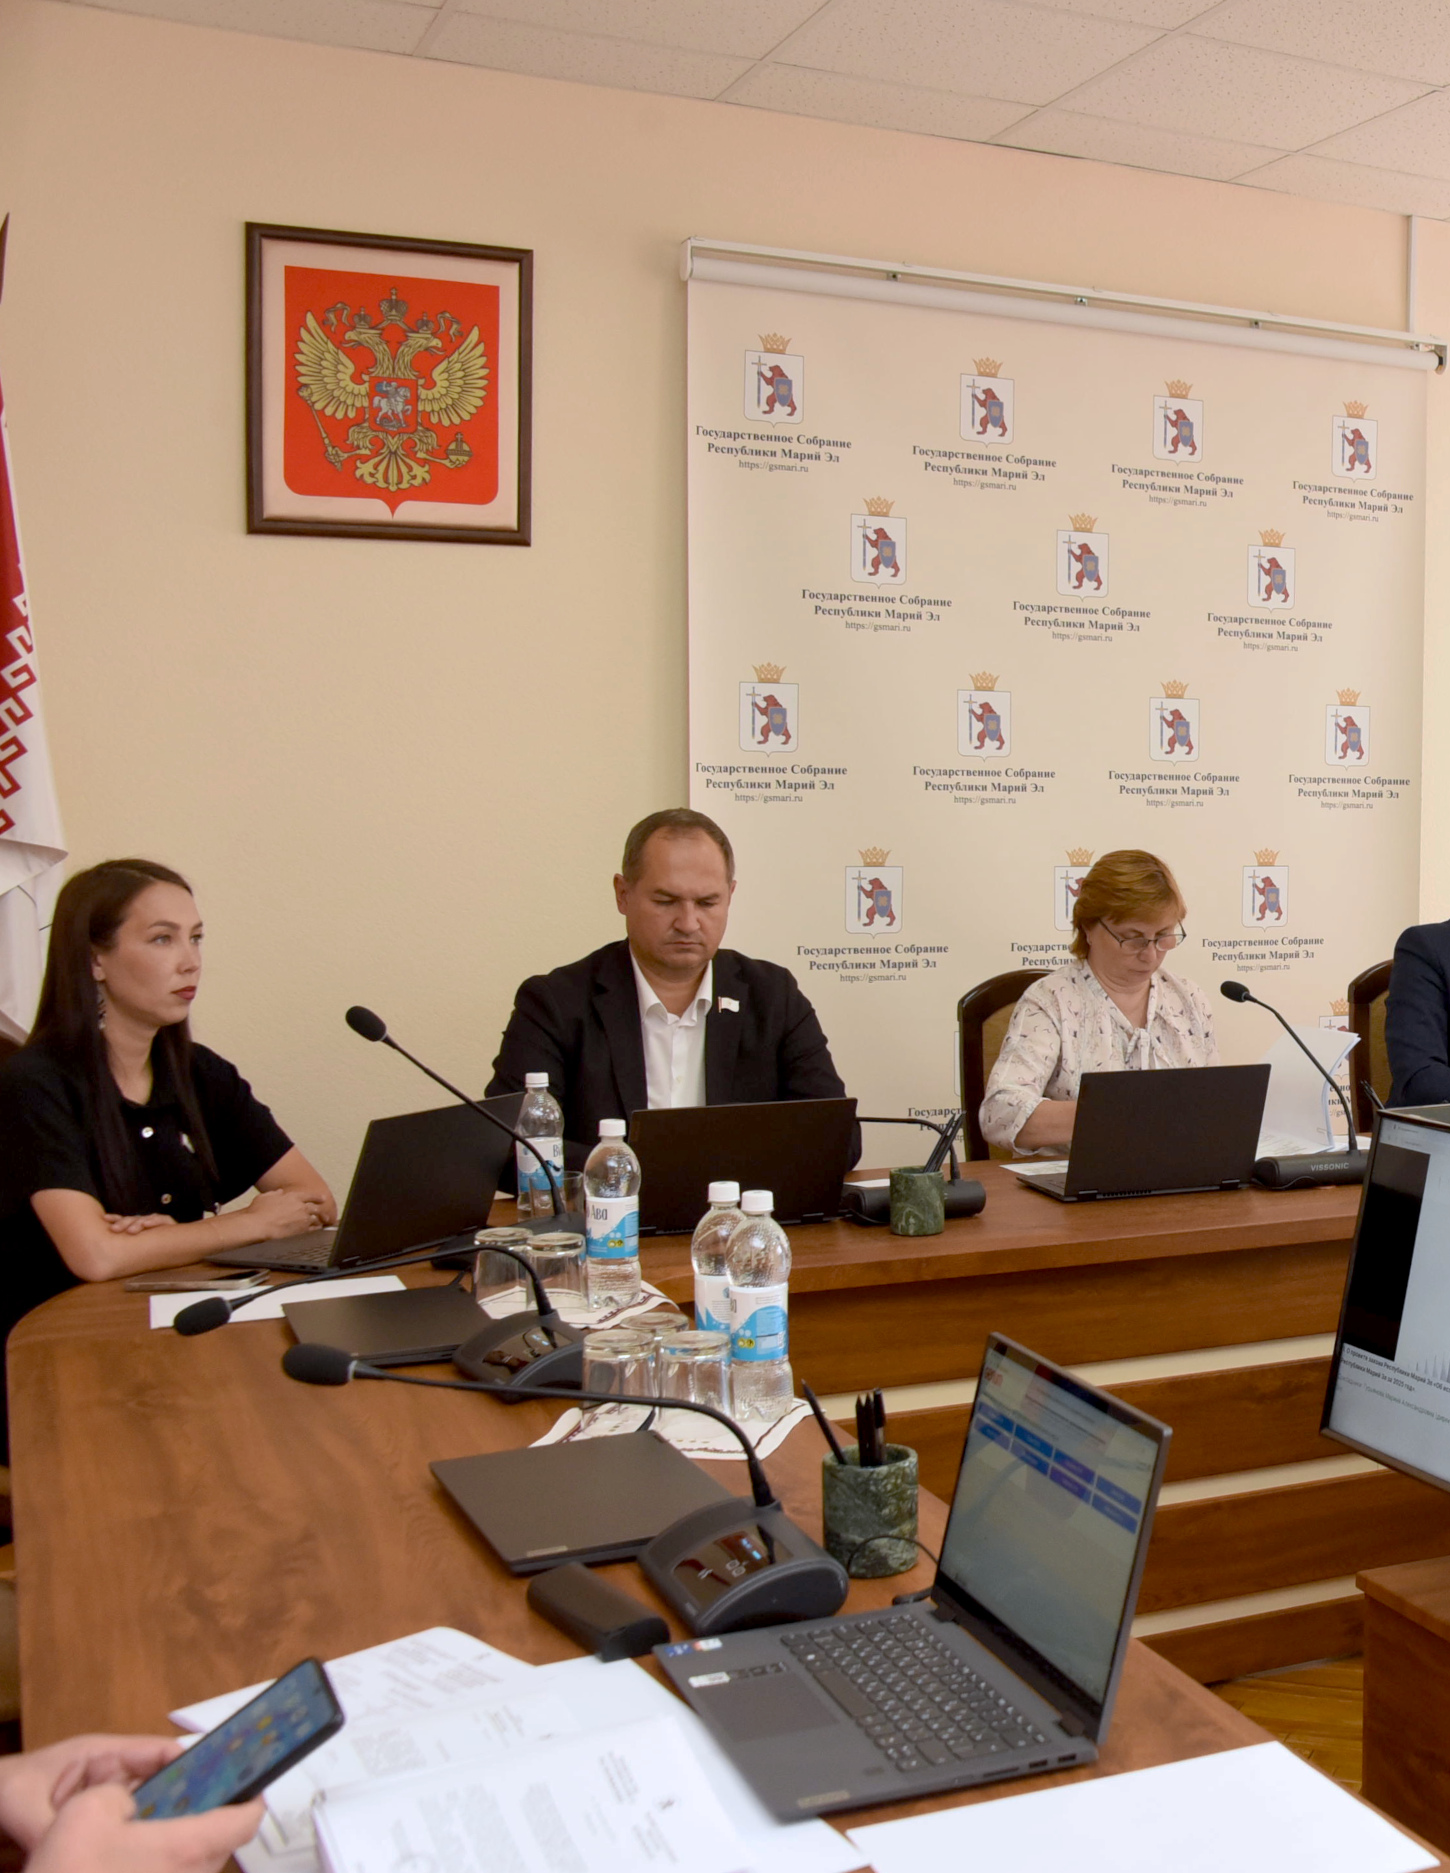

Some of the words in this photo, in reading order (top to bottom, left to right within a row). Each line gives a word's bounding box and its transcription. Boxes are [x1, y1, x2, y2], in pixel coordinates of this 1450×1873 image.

[696, 425, 794, 444] Государственное
[796, 434, 852, 449] Собрание
[707, 442, 777, 458] Республики
[780, 448, 821, 463] Марий
[824, 452, 840, 463] Эл
[912, 445, 1003, 463] Государственное
[1005, 453, 1057, 468] Собрание
[738, 459, 809, 473] https://gsmari.ru
[924, 461, 988, 477] Республики
[991, 467, 1028, 481] Марий
[1031, 470, 1046, 482] Эл
[1111, 463, 1195, 481] Государственное
[1196, 471, 1244, 486] Собрание
[952, 477, 1017, 491] https://gsmari.ru
[1122, 478, 1181, 494] Республики
[1183, 484, 1218, 498] Марий
[1220, 488, 1234, 498] Эл
[1292, 480, 1368, 497] Государственное
[1369, 488, 1415, 502] Собрание
[1148, 494, 1208, 508] https://gsmari.ru
[1302, 495, 1356, 509] Республики
[1358, 500, 1389, 514] Марий
[1391, 504, 1404, 514] Эл
[1326, 509, 1379, 523] https://gsmari.ru
[801, 588, 897, 604] Государственное
[899, 594, 953, 608] Собрание
[814, 604, 882, 619] Республики
[884, 608, 923, 623] Марий
[925, 611, 940, 622] Эл
[1013, 600, 1100, 616] Государственное
[1101, 606, 1151, 620] Собрание
[844, 620, 912, 633] https://gsmari.ru
[1024, 616, 1085, 630] Республики
[1088, 619, 1124, 633] Марий
[1126, 622, 1140, 632] Эл
[1207, 612, 1287, 627] Государственное
[1288, 617, 1333, 630] Собрание
[1051, 630, 1113, 643] https://gsmari.ru
[1217, 627, 1274, 640] Республики
[1276, 630, 1308, 643] Марий
[1310, 632, 1323, 642] Эл
[1242, 640, 1299, 653] https://gsmari.ru
[695, 762, 788, 776] Государственное
[790, 764, 848, 778] Собрание
[912, 765, 1002, 779] Государственное
[1004, 767, 1056, 781] Собрание
[1108, 770, 1192, 783] Государственное
[1193, 772, 1240, 785] Собрание
[705, 778, 772, 792] Республики
[775, 779, 816, 793] Марий
[819, 779, 835, 790] Эл
[924, 780, 988, 794] Республики
[990, 782, 1028, 795] Марий
[1030, 783, 1045, 793] Эл
[1288, 773, 1362, 786] Государственное
[1363, 775, 1411, 788] Собрание
[734, 792, 804, 804] https://gsmari.ru
[1119, 784, 1178, 797] Республики
[1180, 785, 1214, 798] Марий
[1216, 786, 1230, 796] Эл
[1297, 787, 1349, 800] Республики
[1351, 788, 1384, 801] Марий
[1385, 789, 1400, 800] Эл
[953, 794, 1017, 806] https://gsmari.ru
[1145, 798, 1204, 809] https://gsmari.ru
[1320, 800, 1374, 811] https://gsmari.ru
[797, 945, 892, 958] Государственное
[894, 943, 949, 956] Собрание
[1010, 942, 1073, 953] Государств
[1202, 938, 1279, 950] Государственное
[1280, 936, 1325, 948] Собрание
[1022, 957, 1073, 968] Республи
[1211, 951, 1267, 963] Республики
[1269, 950, 1300, 962] Марий
[1302, 949, 1315, 959] Эл
[809, 959, 877, 973] Республики
[879, 959, 919, 972] Марий
[921, 958, 937, 969] Эл
[1236, 962, 1291, 974] https://gsmari.ru
[839, 972, 907, 984] https://gsmari.ru
[907, 1107, 962, 1118] Государст
[1310, 1162, 1350, 1172] VISSONIC
